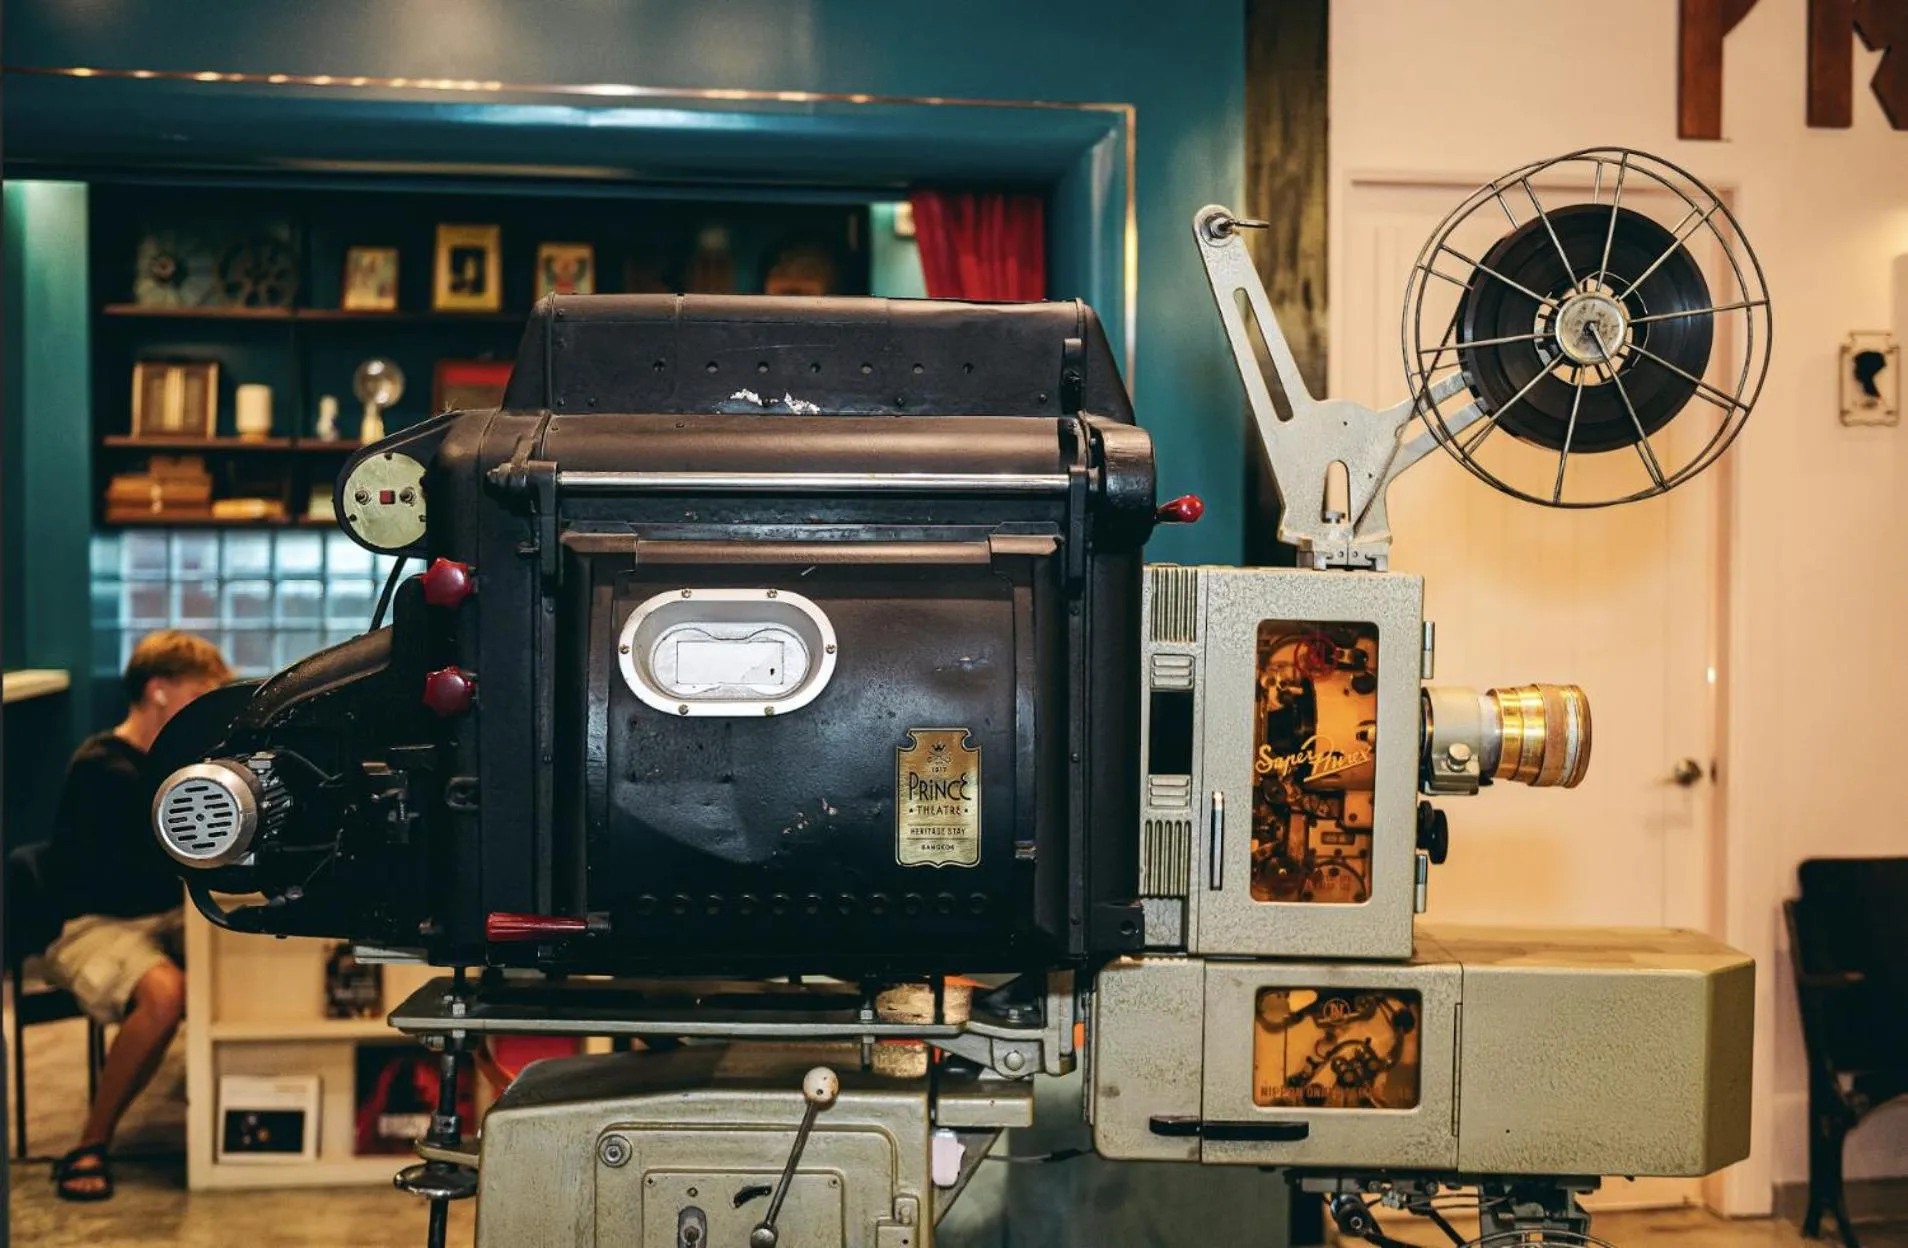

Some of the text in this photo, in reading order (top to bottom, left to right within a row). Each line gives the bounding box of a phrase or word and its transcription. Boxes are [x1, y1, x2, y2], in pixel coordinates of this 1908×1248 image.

[916, 804, 961, 816] THEATRE
[910, 827, 966, 836] HERITAGE STAY
